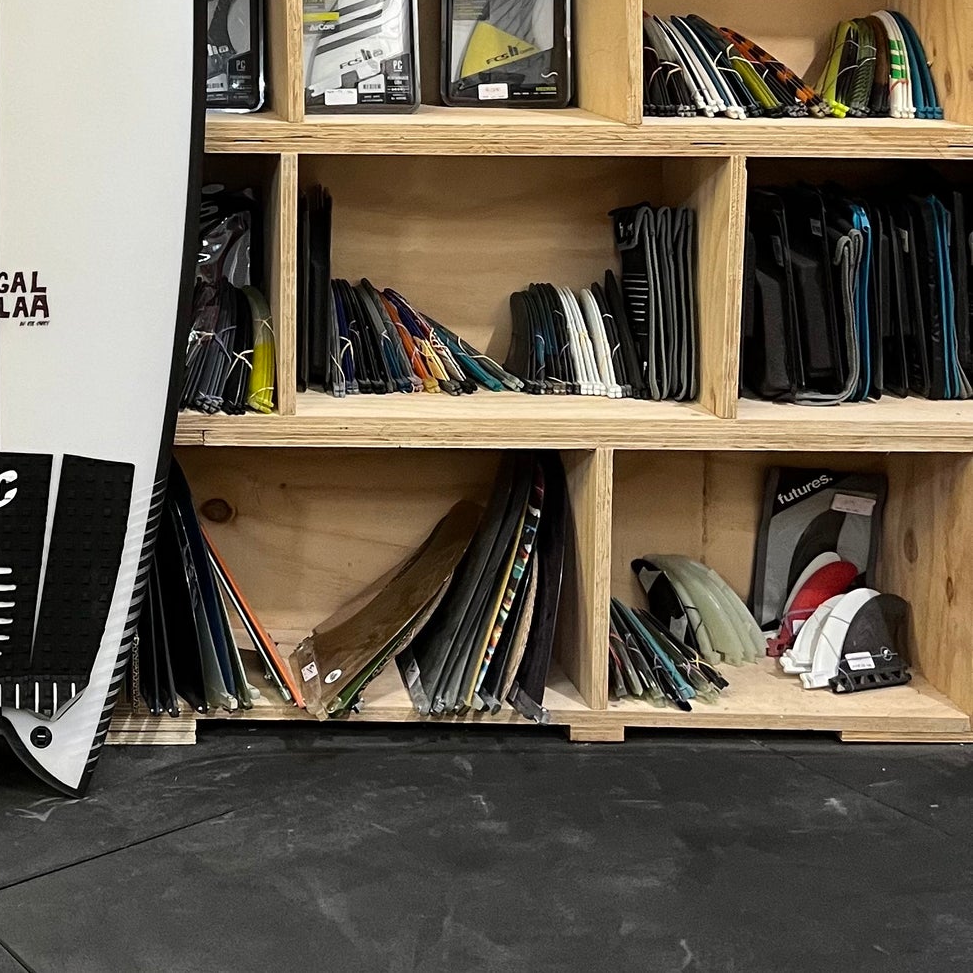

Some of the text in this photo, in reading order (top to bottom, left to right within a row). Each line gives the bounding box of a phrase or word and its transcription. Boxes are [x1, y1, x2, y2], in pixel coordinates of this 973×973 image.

[339, 57, 363, 69] FCS
[486, 52, 510, 64] FCS
[777, 474, 833, 505] futures.
